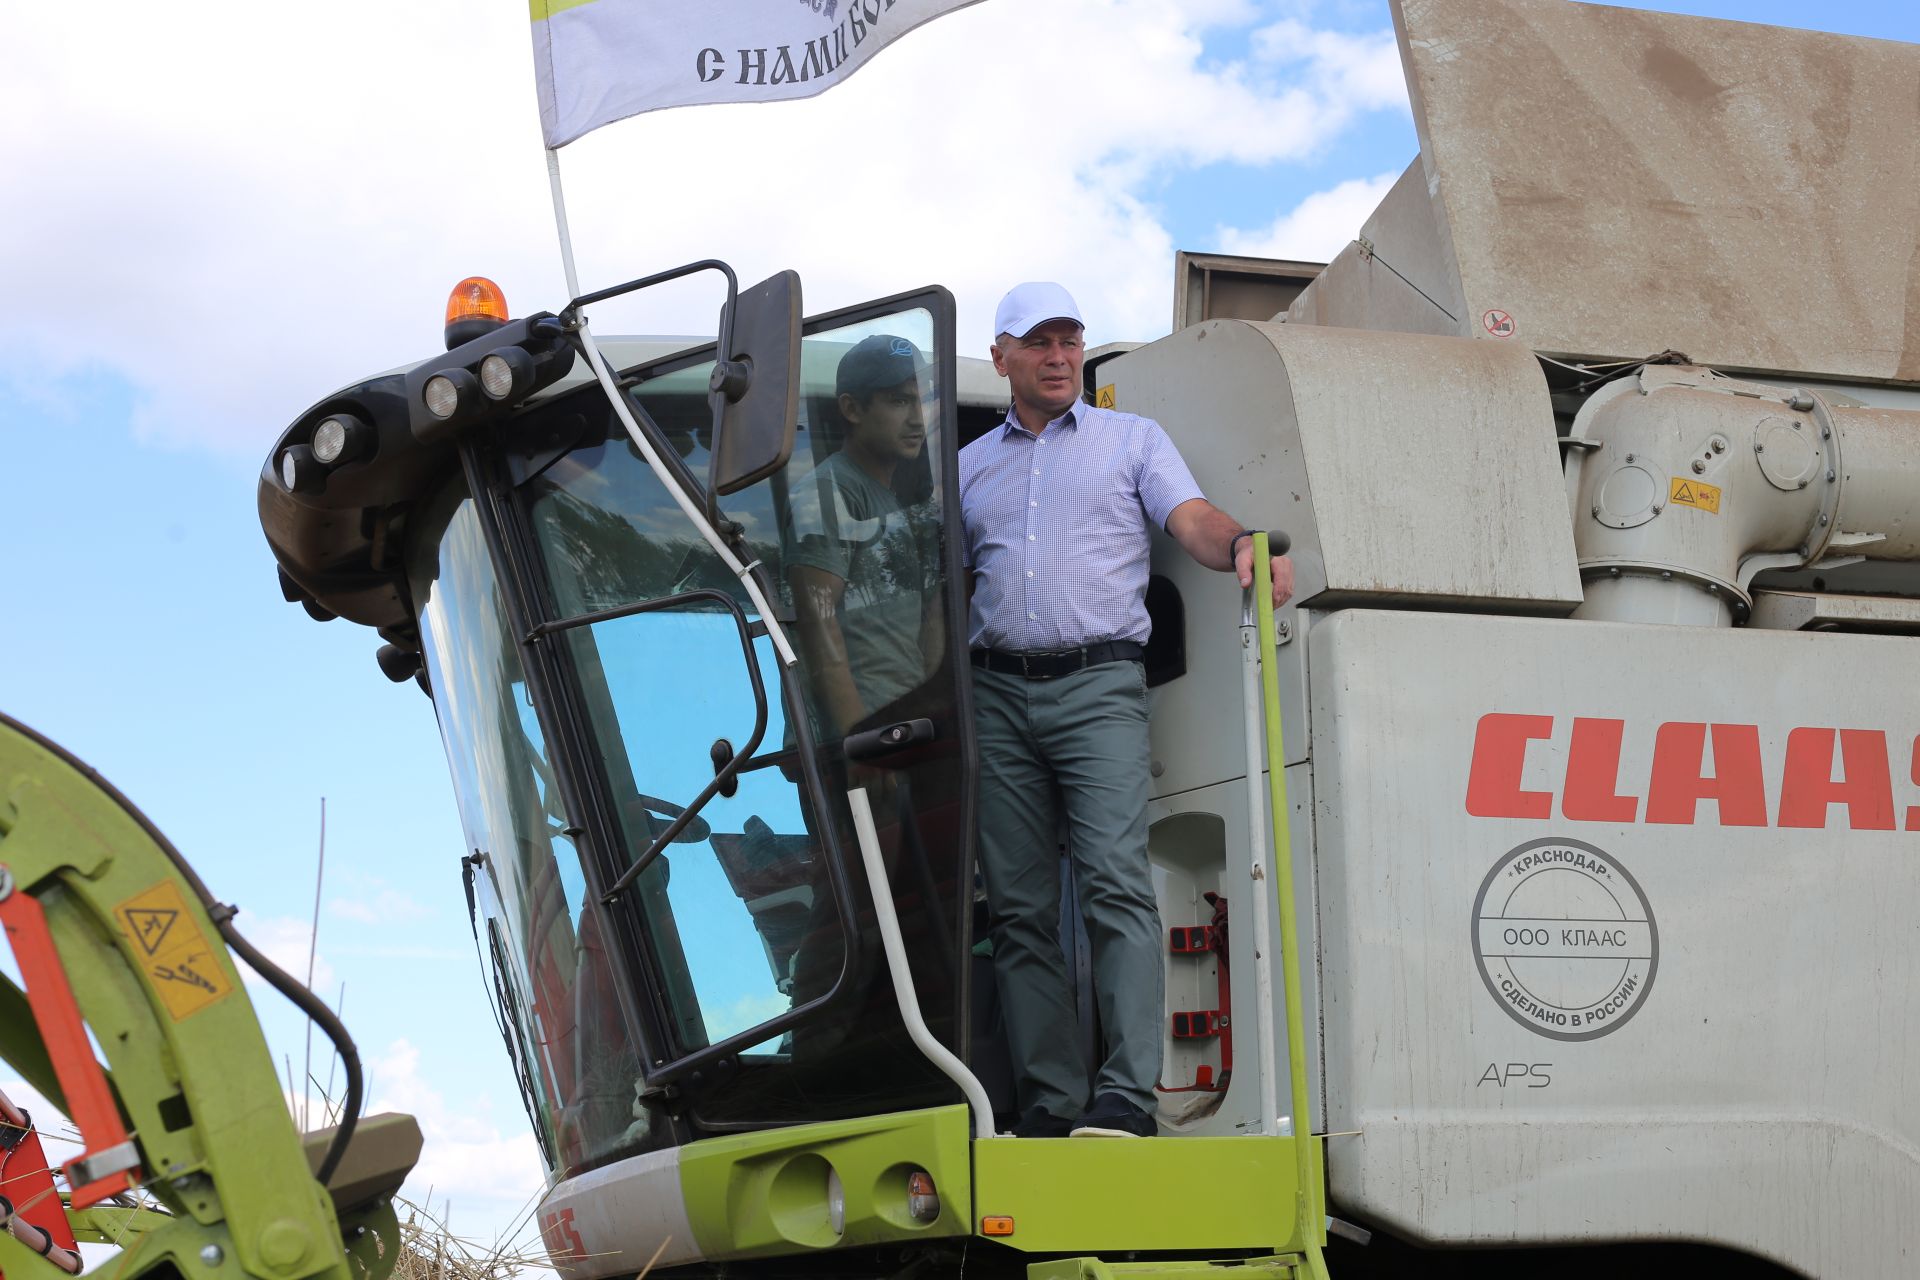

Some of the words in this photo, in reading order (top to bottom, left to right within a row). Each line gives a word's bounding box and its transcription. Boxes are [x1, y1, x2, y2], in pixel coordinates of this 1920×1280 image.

[696, 47, 725, 82] С
[848, 0, 896, 48] БО
[1465, 712, 1920, 832] CLAA
[1513, 850, 1607, 876] КРАСНОДАР
[1503, 928, 1550, 946] ООО
[1561, 929, 1627, 947] КЛААС
[1501, 979, 1567, 1027] СДЕЛАНО
[1571, 1014, 1582, 1027] В
[1585, 977, 1638, 1024] РОССИИ
[1476, 1062, 1553, 1088] APS
